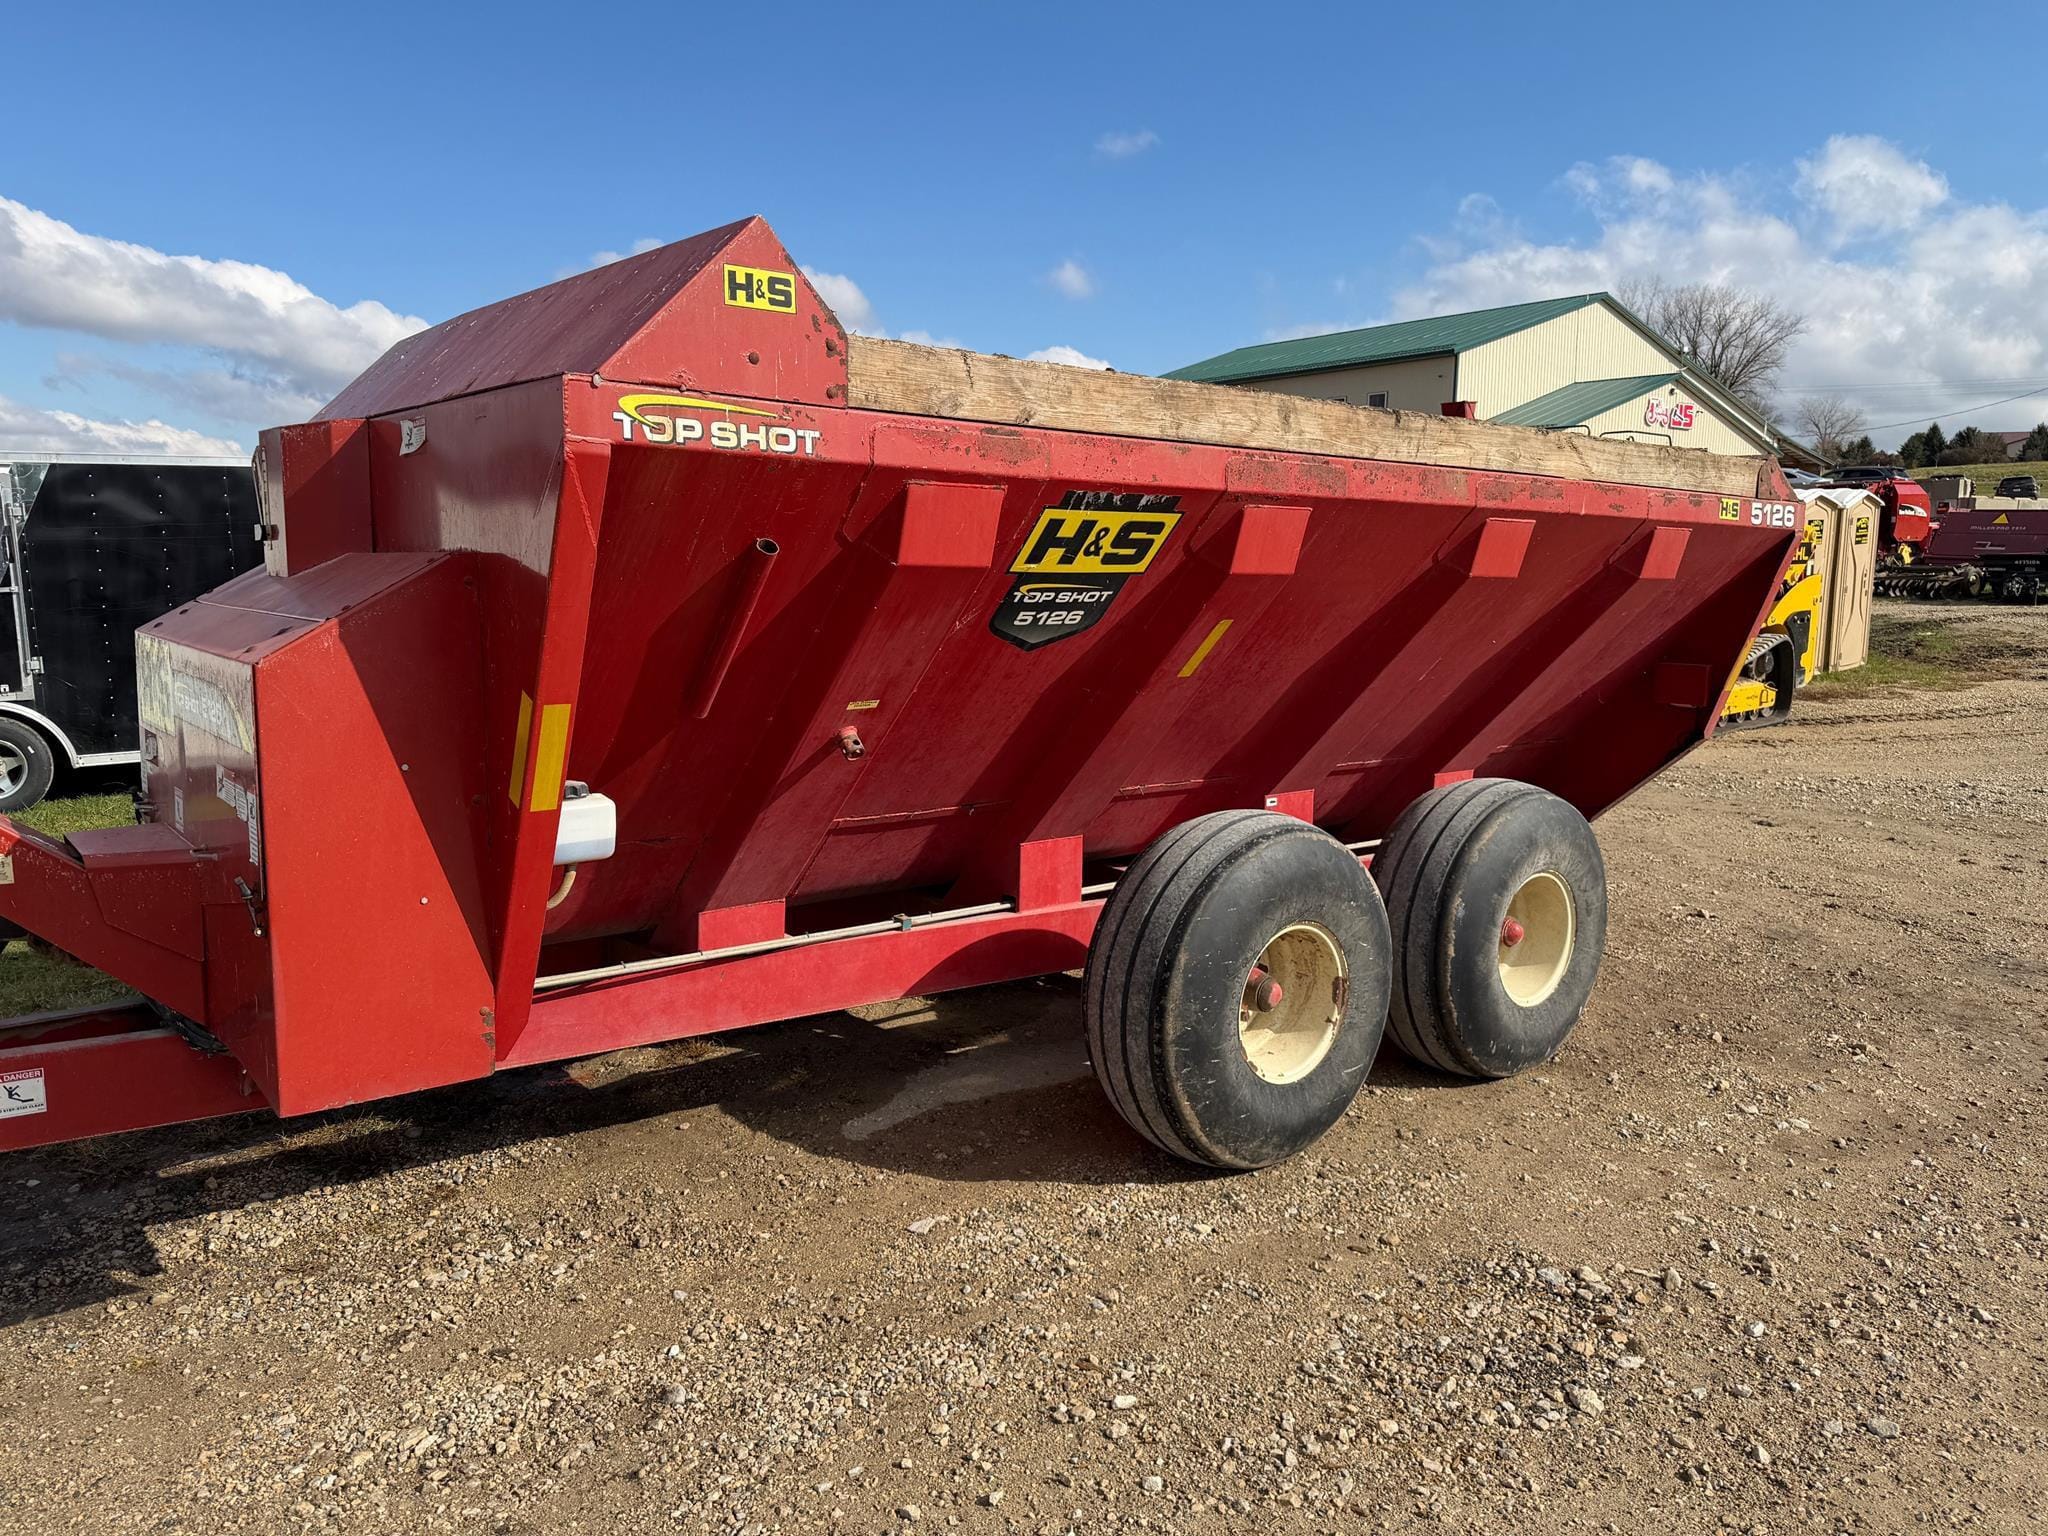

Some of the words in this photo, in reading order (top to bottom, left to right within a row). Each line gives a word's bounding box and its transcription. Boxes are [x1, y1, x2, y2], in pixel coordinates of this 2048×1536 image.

[727, 269, 793, 309] H&S
[612, 411, 704, 445] TOP
[710, 421, 821, 454] SHOT
[1750, 501, 1795, 528] 5126
[1023, 517, 1166, 566] H&S
[1013, 590, 1056, 604] TOP
[1055, 591, 1114, 604] SHOT
[1013, 610, 1085, 626] 5126
[3, 1070, 41, 1082] DANGER
